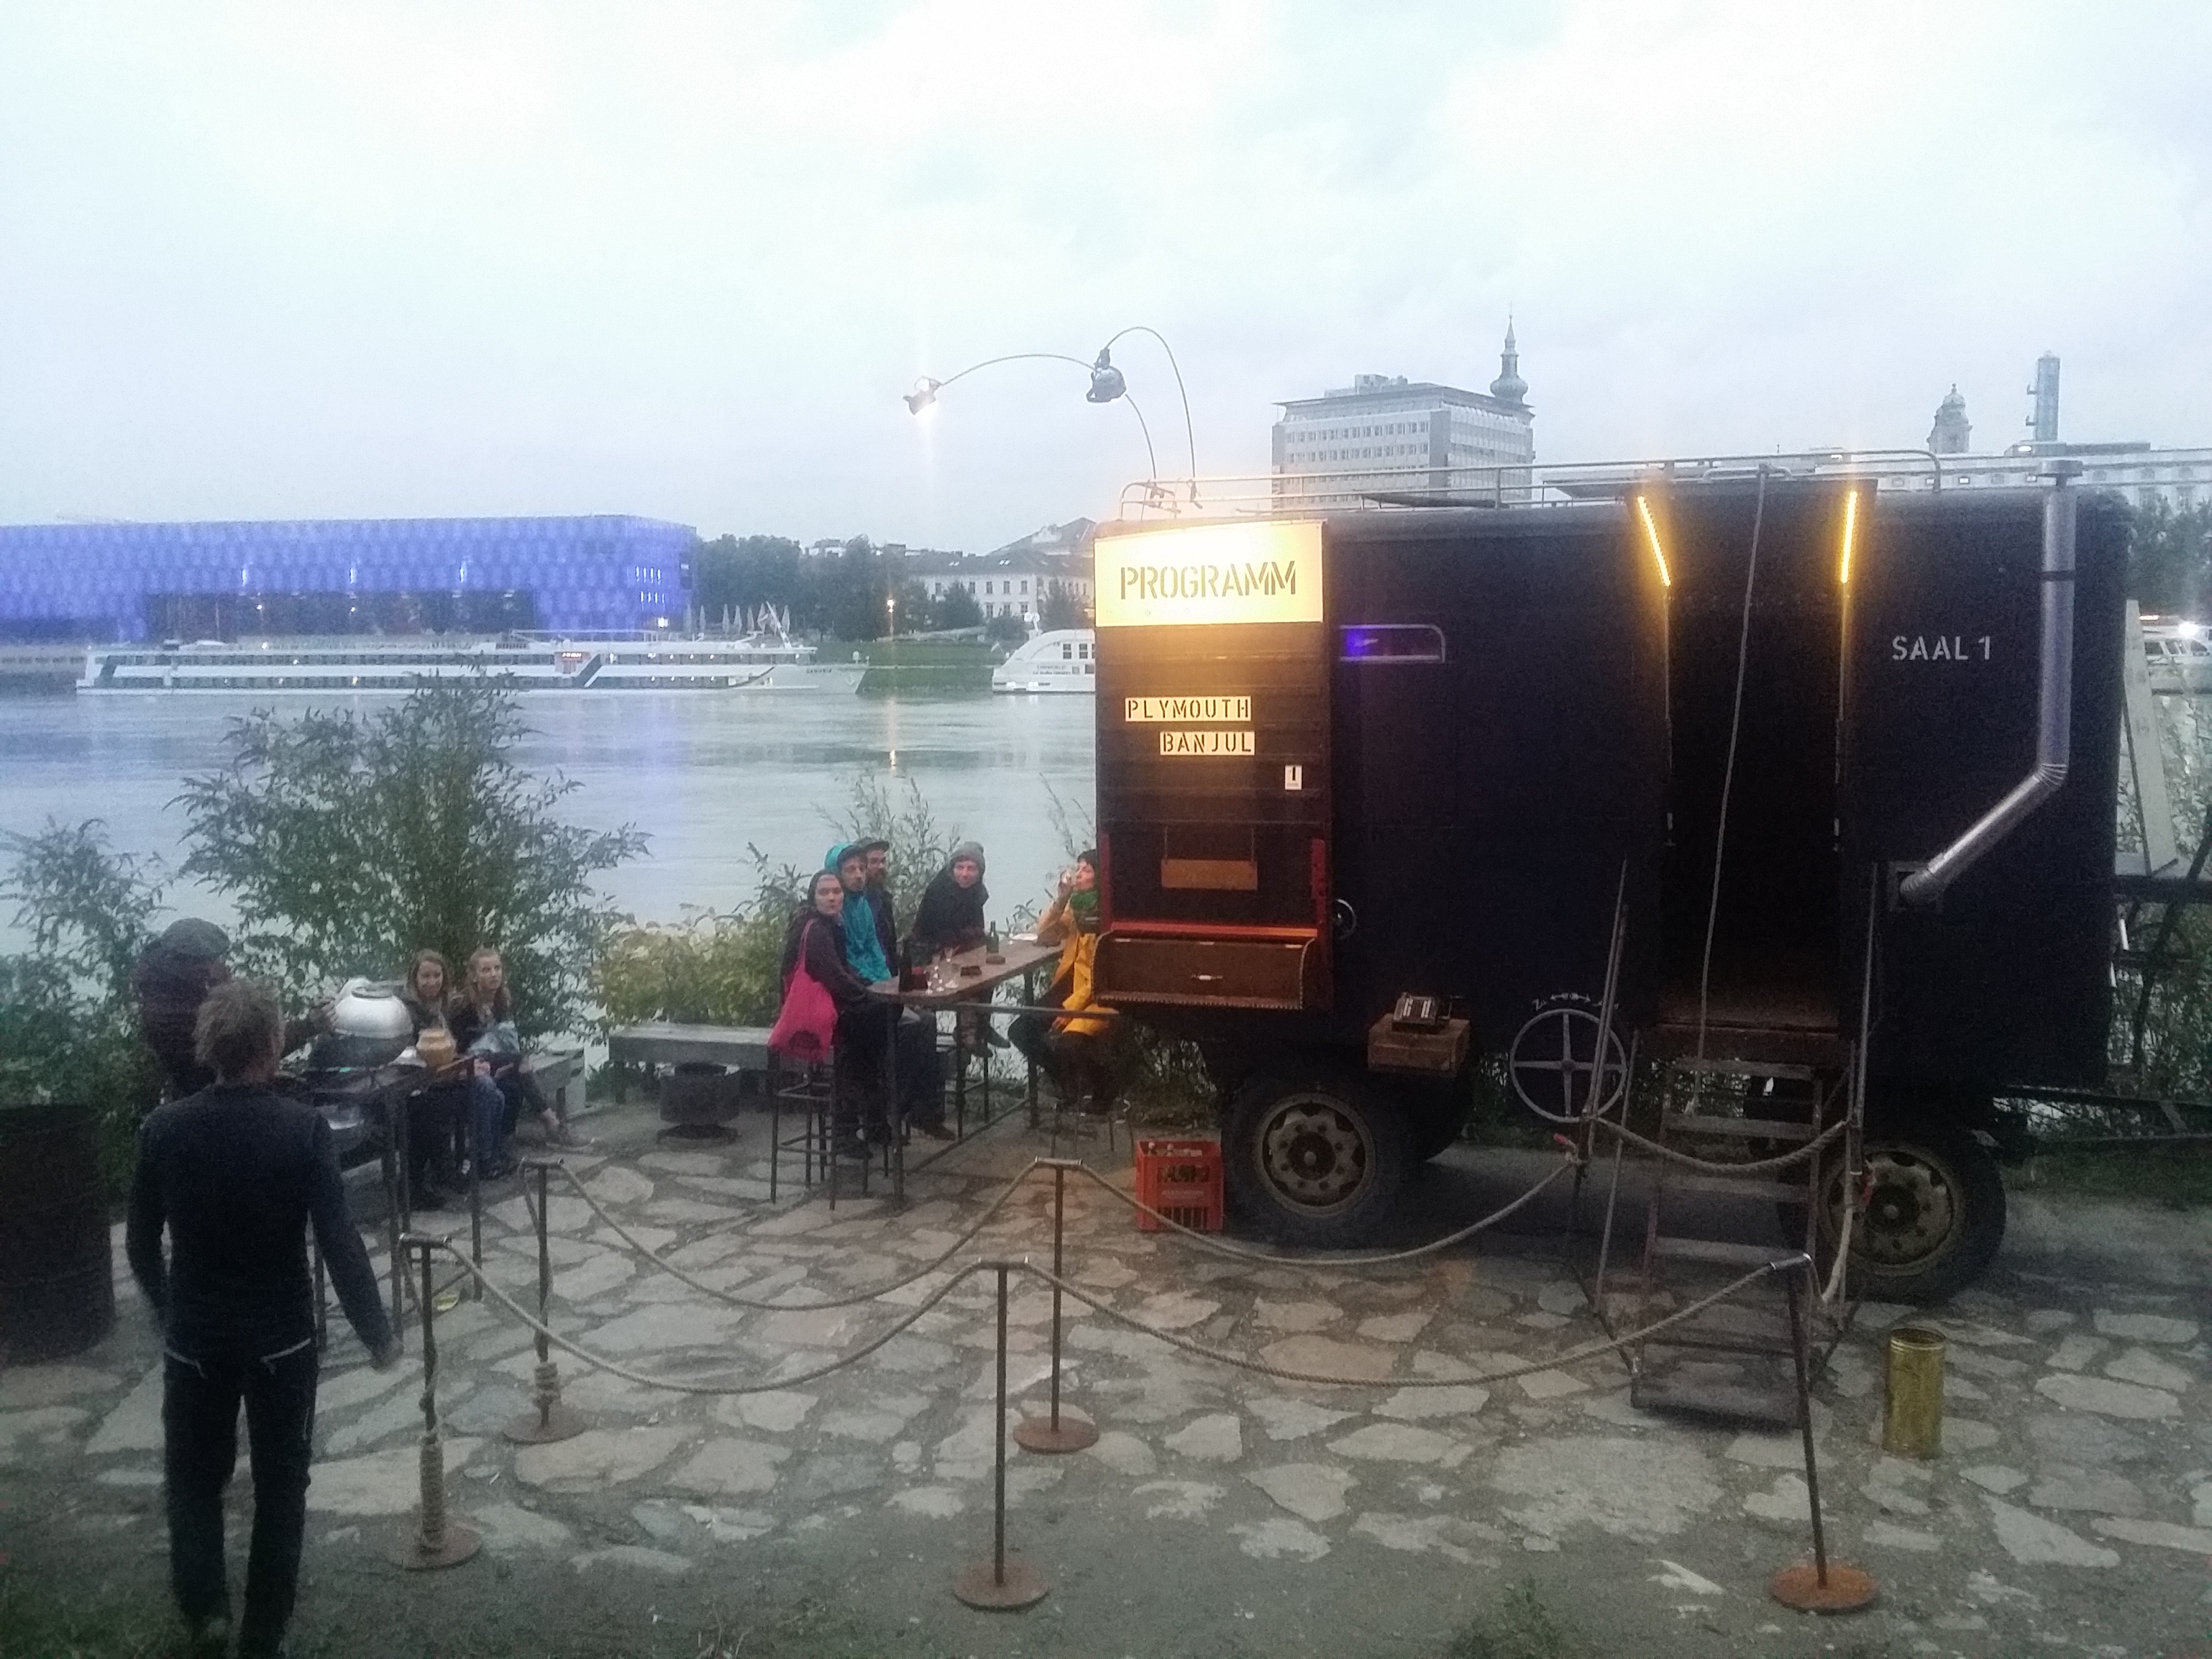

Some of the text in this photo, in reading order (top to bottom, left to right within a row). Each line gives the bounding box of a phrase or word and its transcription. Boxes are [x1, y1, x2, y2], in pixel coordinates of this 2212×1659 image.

[1121, 560, 1296, 600] PROGRAMM
[1892, 636, 1990, 660] SAAL 1
[1128, 699, 1249, 719] PLYMOUTH
[1162, 733, 1252, 754] BANJUL
